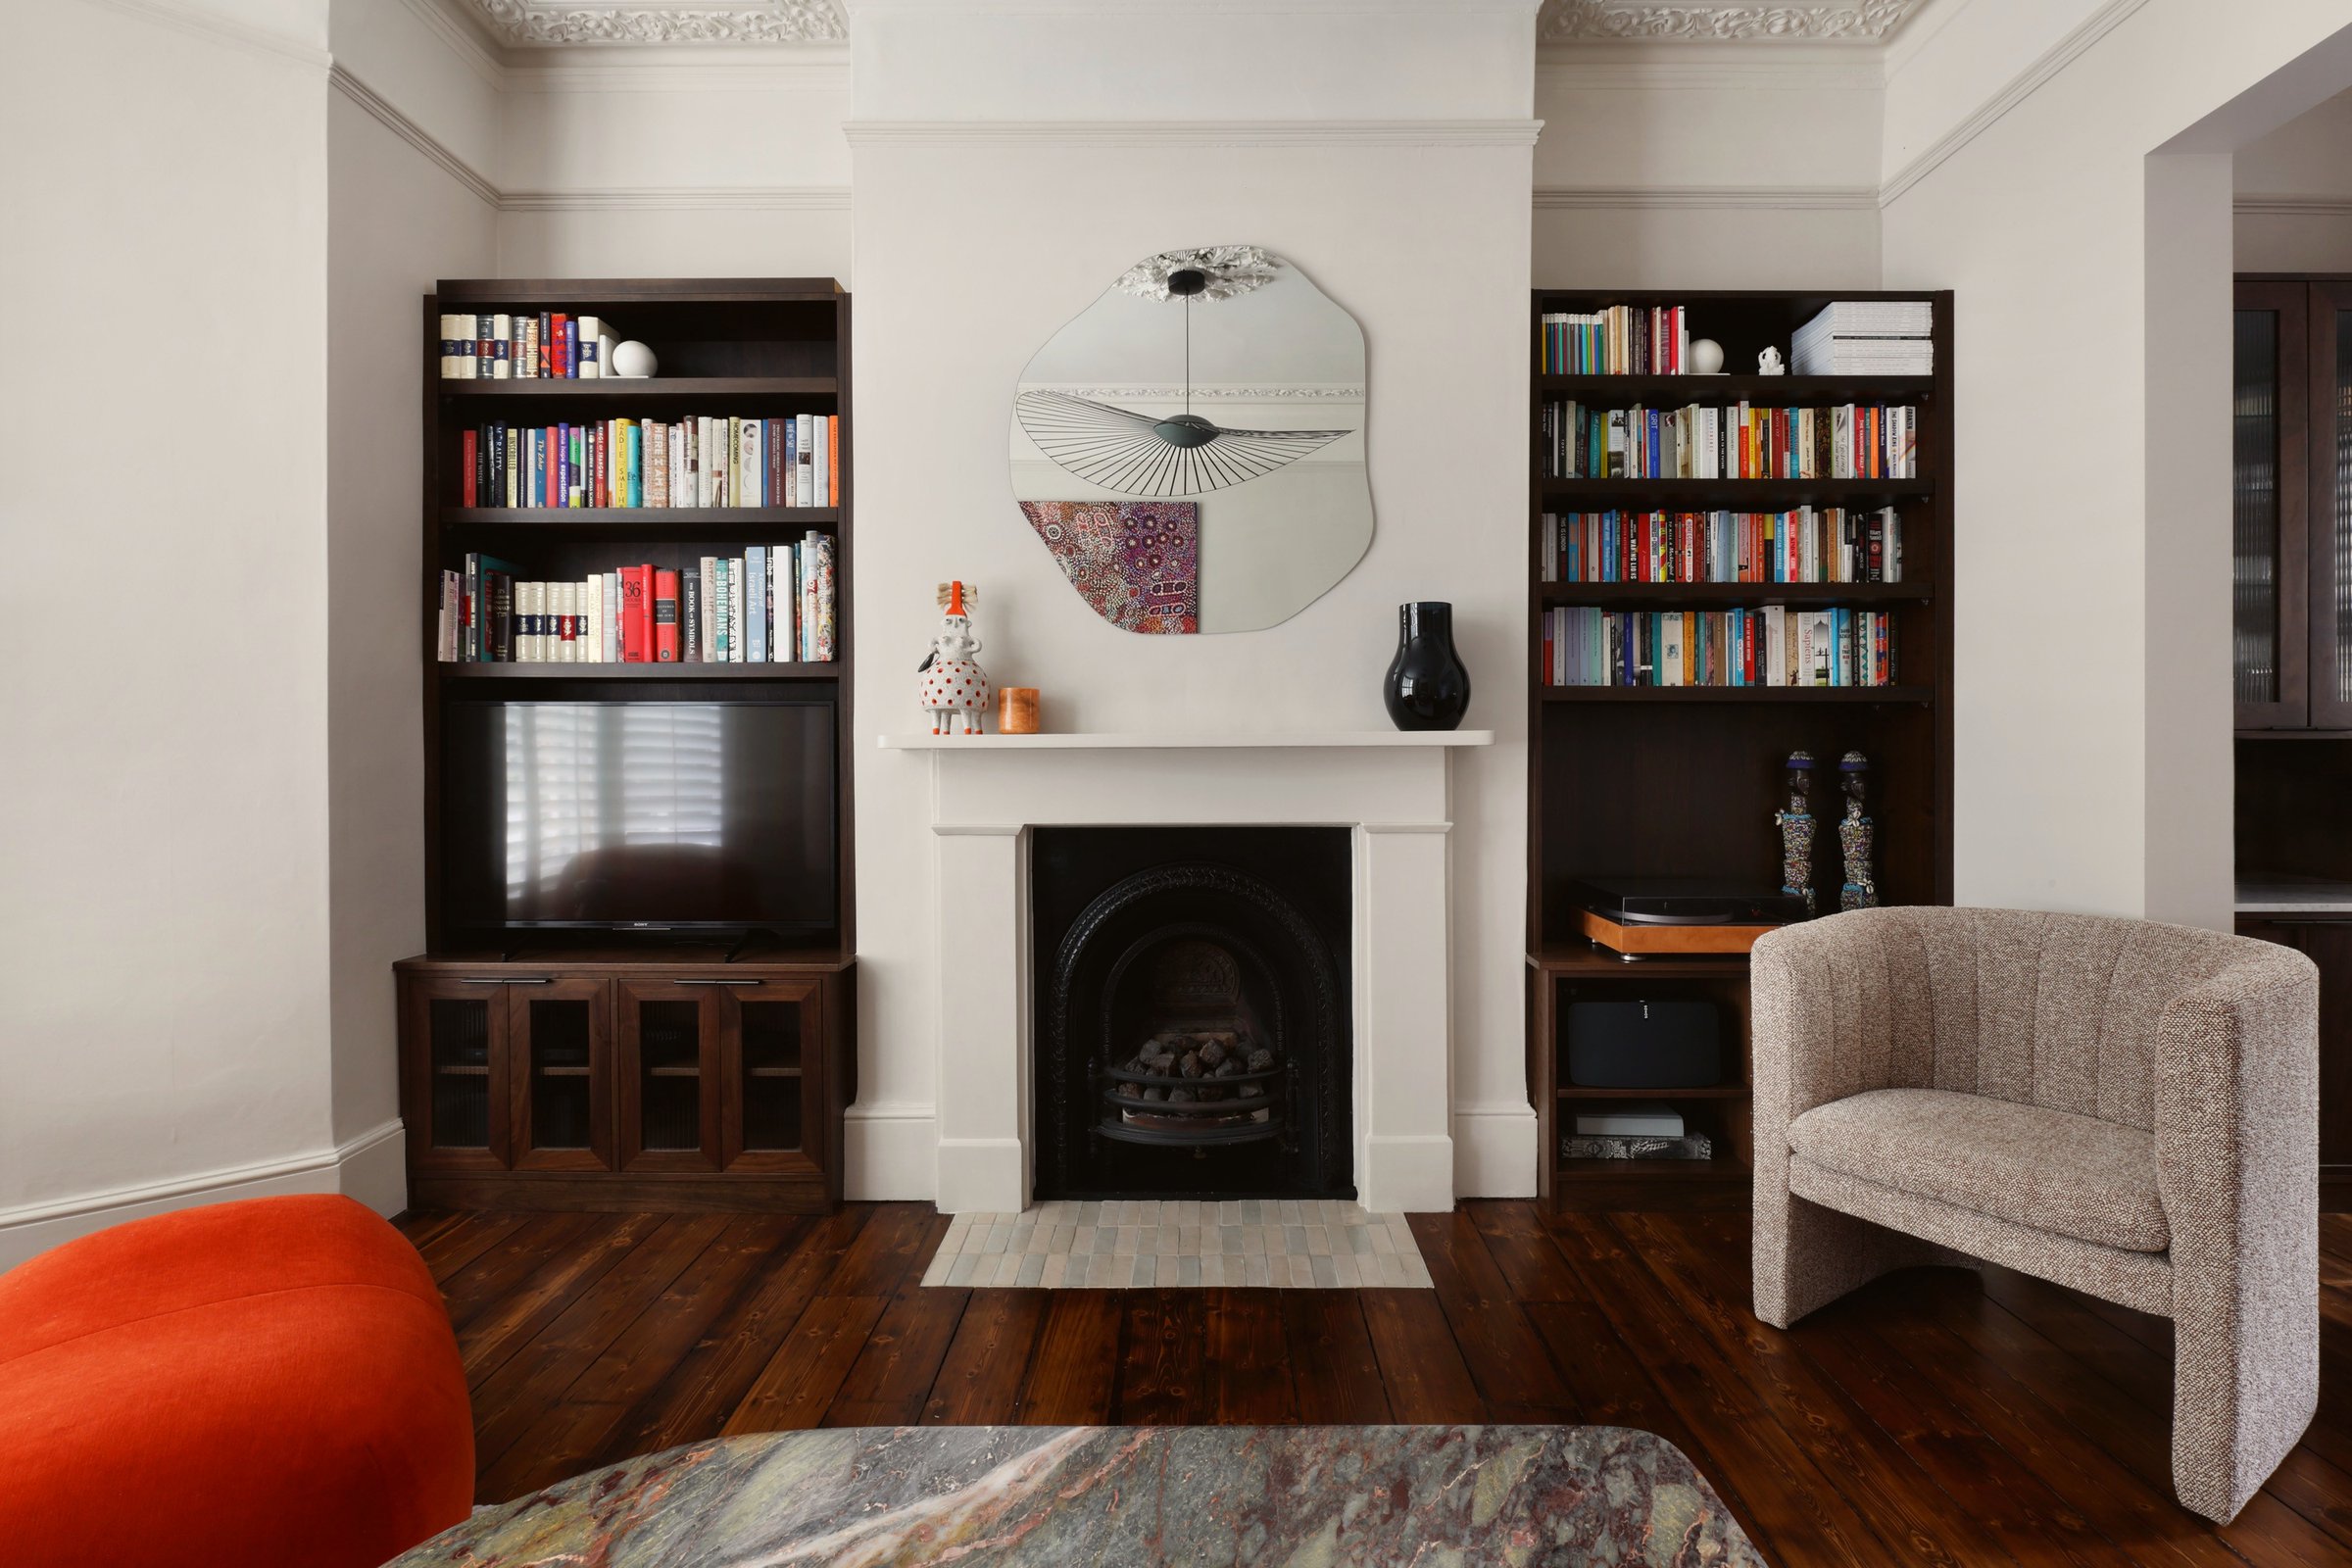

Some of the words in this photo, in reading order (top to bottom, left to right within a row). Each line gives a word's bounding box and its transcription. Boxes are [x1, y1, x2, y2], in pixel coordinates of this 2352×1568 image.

[655, 426, 663, 456] HERE
[655, 469, 663, 487] AM
[625, 581, 641, 598] 36
[716, 581, 728, 636] BOHEMIANS
[1803, 629, 1813, 664] Sapiens
